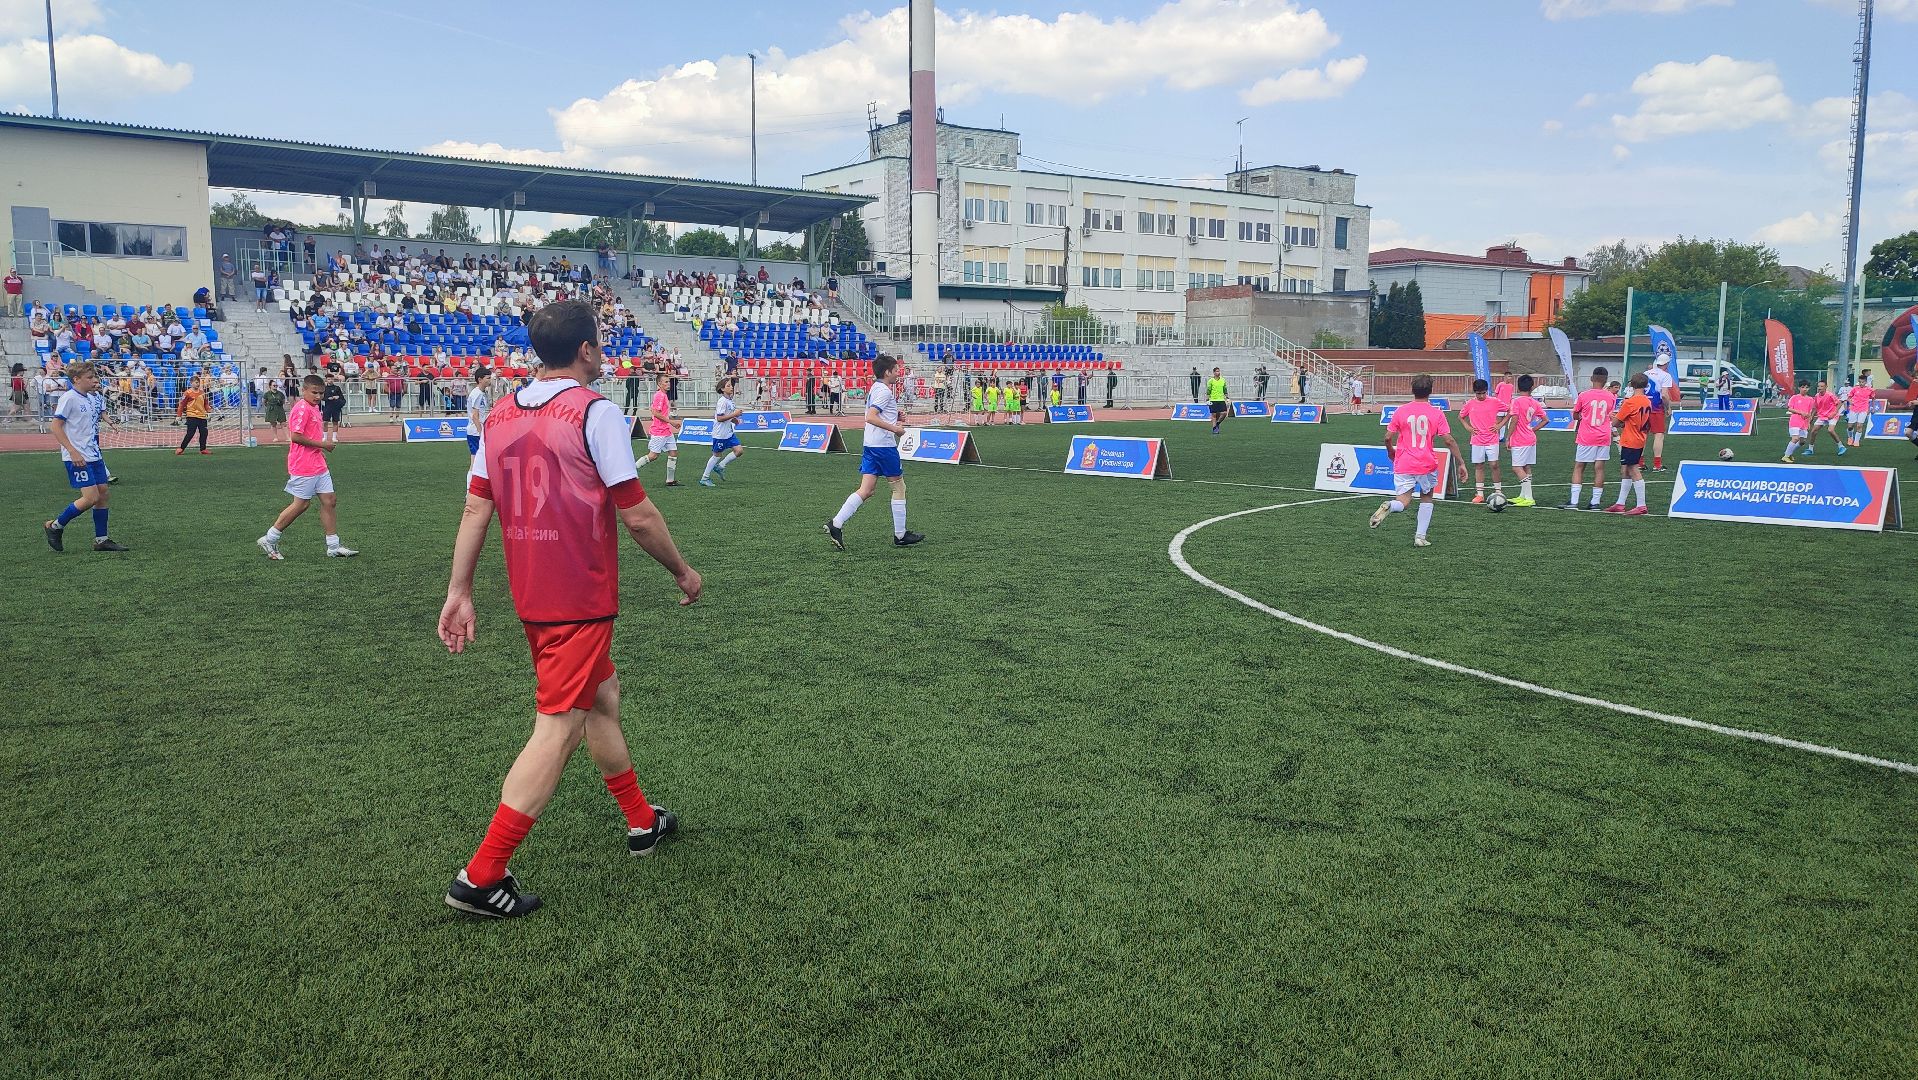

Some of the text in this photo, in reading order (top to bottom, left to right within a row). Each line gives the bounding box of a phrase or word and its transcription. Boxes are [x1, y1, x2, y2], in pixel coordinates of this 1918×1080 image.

[1591, 399, 1607, 426] 13
[1407, 415, 1429, 448] 19
[74, 471, 88, 482] 29
[504, 455, 549, 518] 19
[1695, 478, 1813, 492] #ВЫХОДИВОДВОР
[1694, 490, 1860, 508] #КОМАНДАГУБЕРНАТОРА
